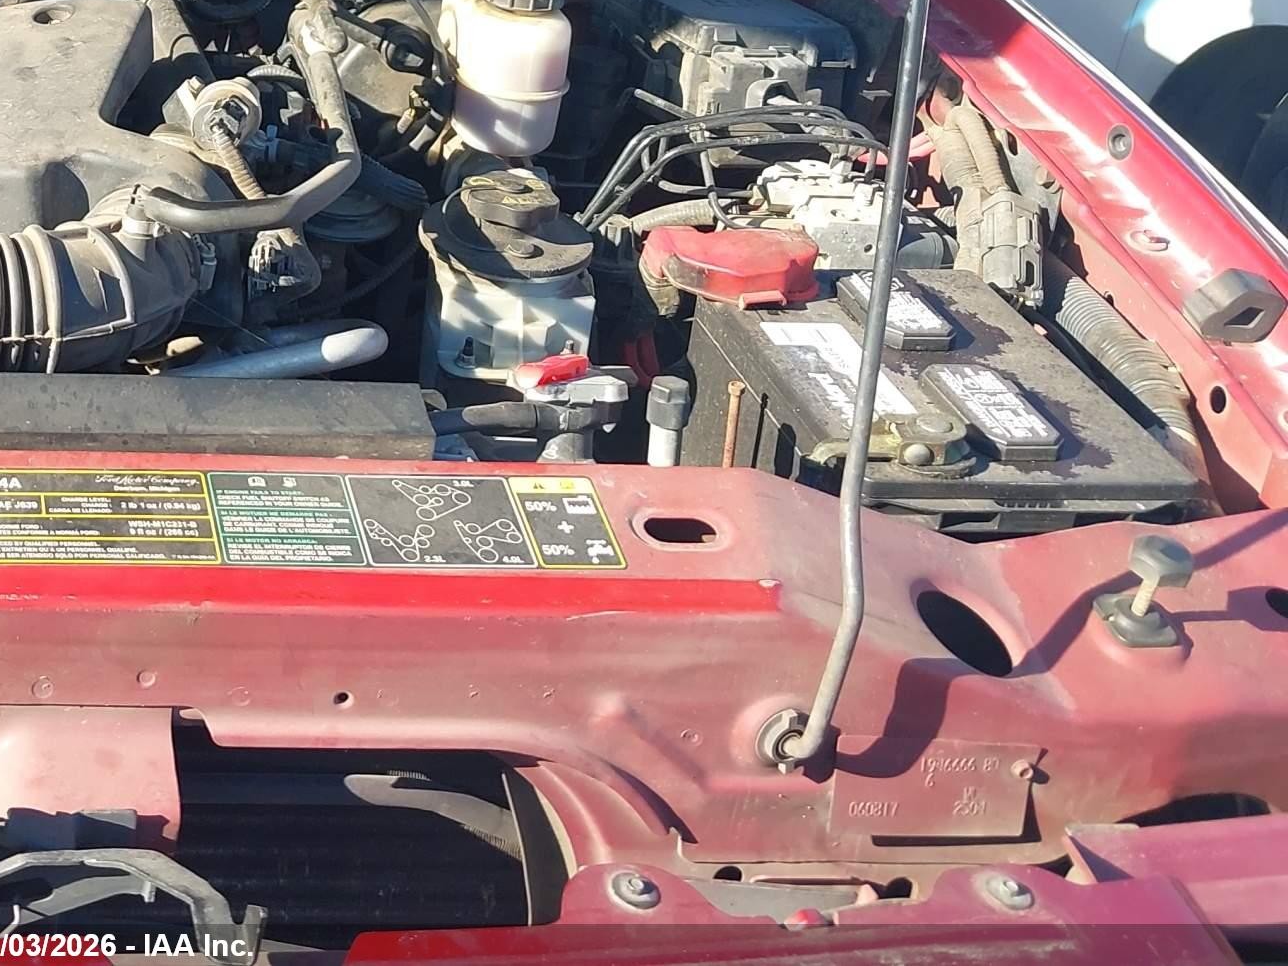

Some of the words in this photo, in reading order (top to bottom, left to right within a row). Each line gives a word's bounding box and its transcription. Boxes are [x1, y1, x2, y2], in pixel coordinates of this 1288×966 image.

[452, 480, 474, 488] 3.0L
[14, 501, 38, 509] J639
[524, 501, 557, 512] 50%
[541, 544, 575, 556] 50%
[423, 555, 446, 563] 2.3L
[502, 555, 525, 564] 4.0L
